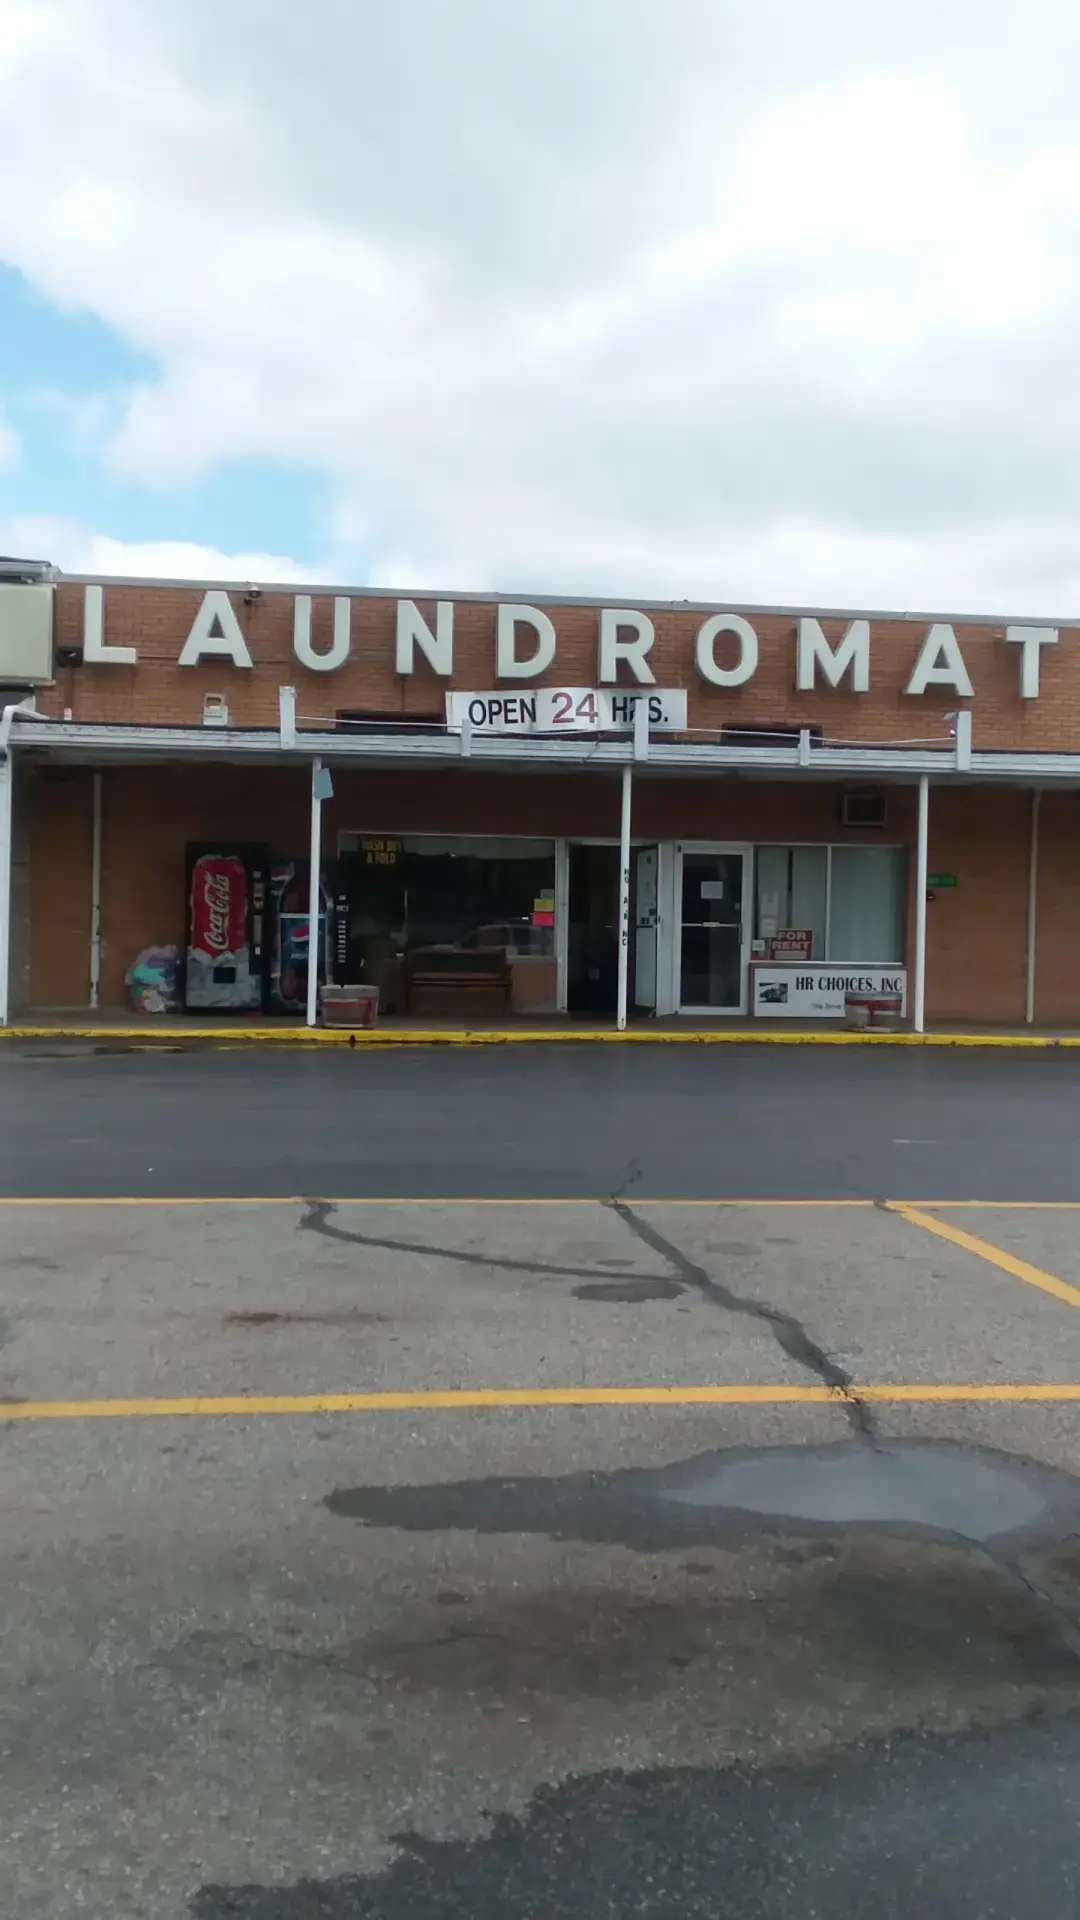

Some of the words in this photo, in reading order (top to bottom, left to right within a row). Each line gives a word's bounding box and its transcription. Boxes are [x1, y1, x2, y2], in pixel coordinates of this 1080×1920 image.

[83, 585, 1059, 699] LAUNDROMAT
[468, 698, 537, 726] OPEN
[551, 692, 598, 724] 24
[777, 931, 807, 941] FOR
[771, 941, 811, 950] RENT
[795, 976, 814, 991] HR
[881, 977, 903, 992] INC
